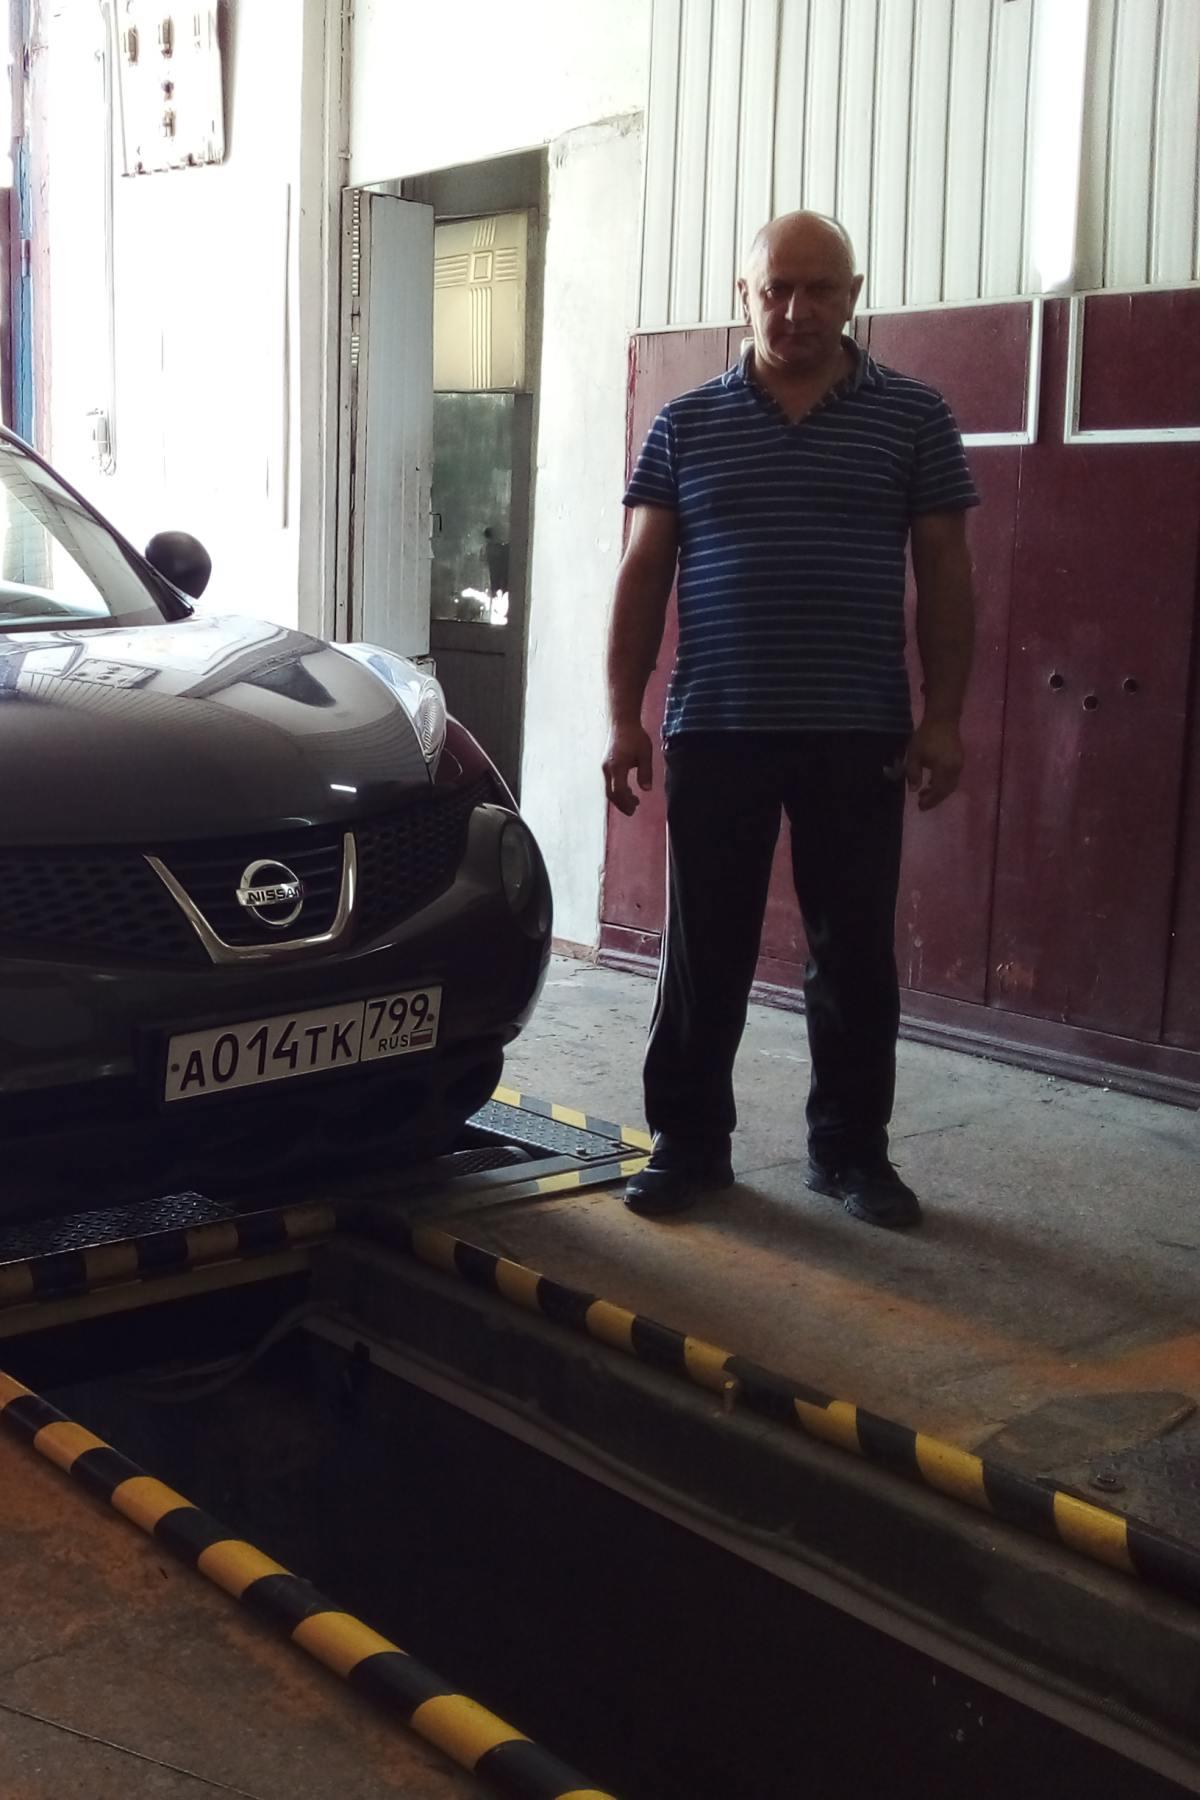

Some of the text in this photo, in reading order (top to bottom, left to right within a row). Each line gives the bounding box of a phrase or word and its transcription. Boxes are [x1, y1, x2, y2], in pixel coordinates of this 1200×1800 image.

[180, 993, 430, 1091] A014TK 799
[378, 1033, 410, 1052] RUS
